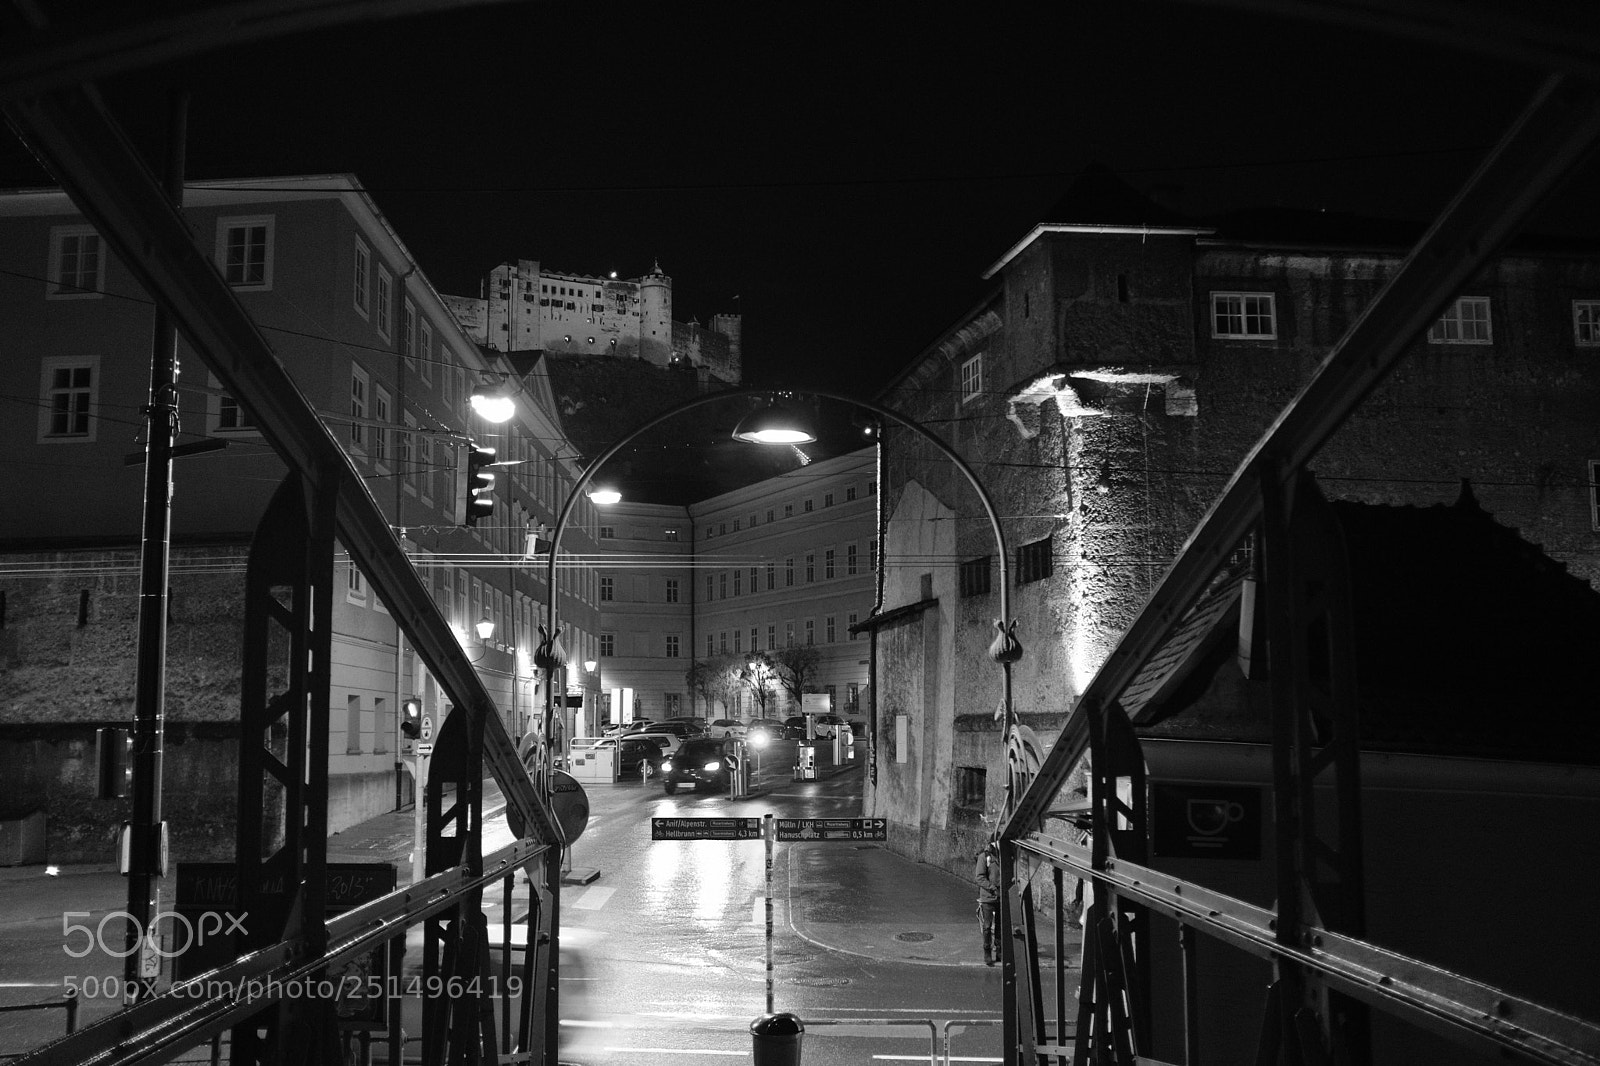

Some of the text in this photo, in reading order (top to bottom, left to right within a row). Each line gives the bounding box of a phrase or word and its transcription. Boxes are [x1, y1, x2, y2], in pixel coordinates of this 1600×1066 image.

[802, 820, 814, 828] LKH
[665, 829, 696, 838] Hellbrunn
[738, 829, 747, 838] 4,3
[748, 829, 758, 838] km
[852, 831, 863, 840] 0,5
[863, 831, 873, 839] km
